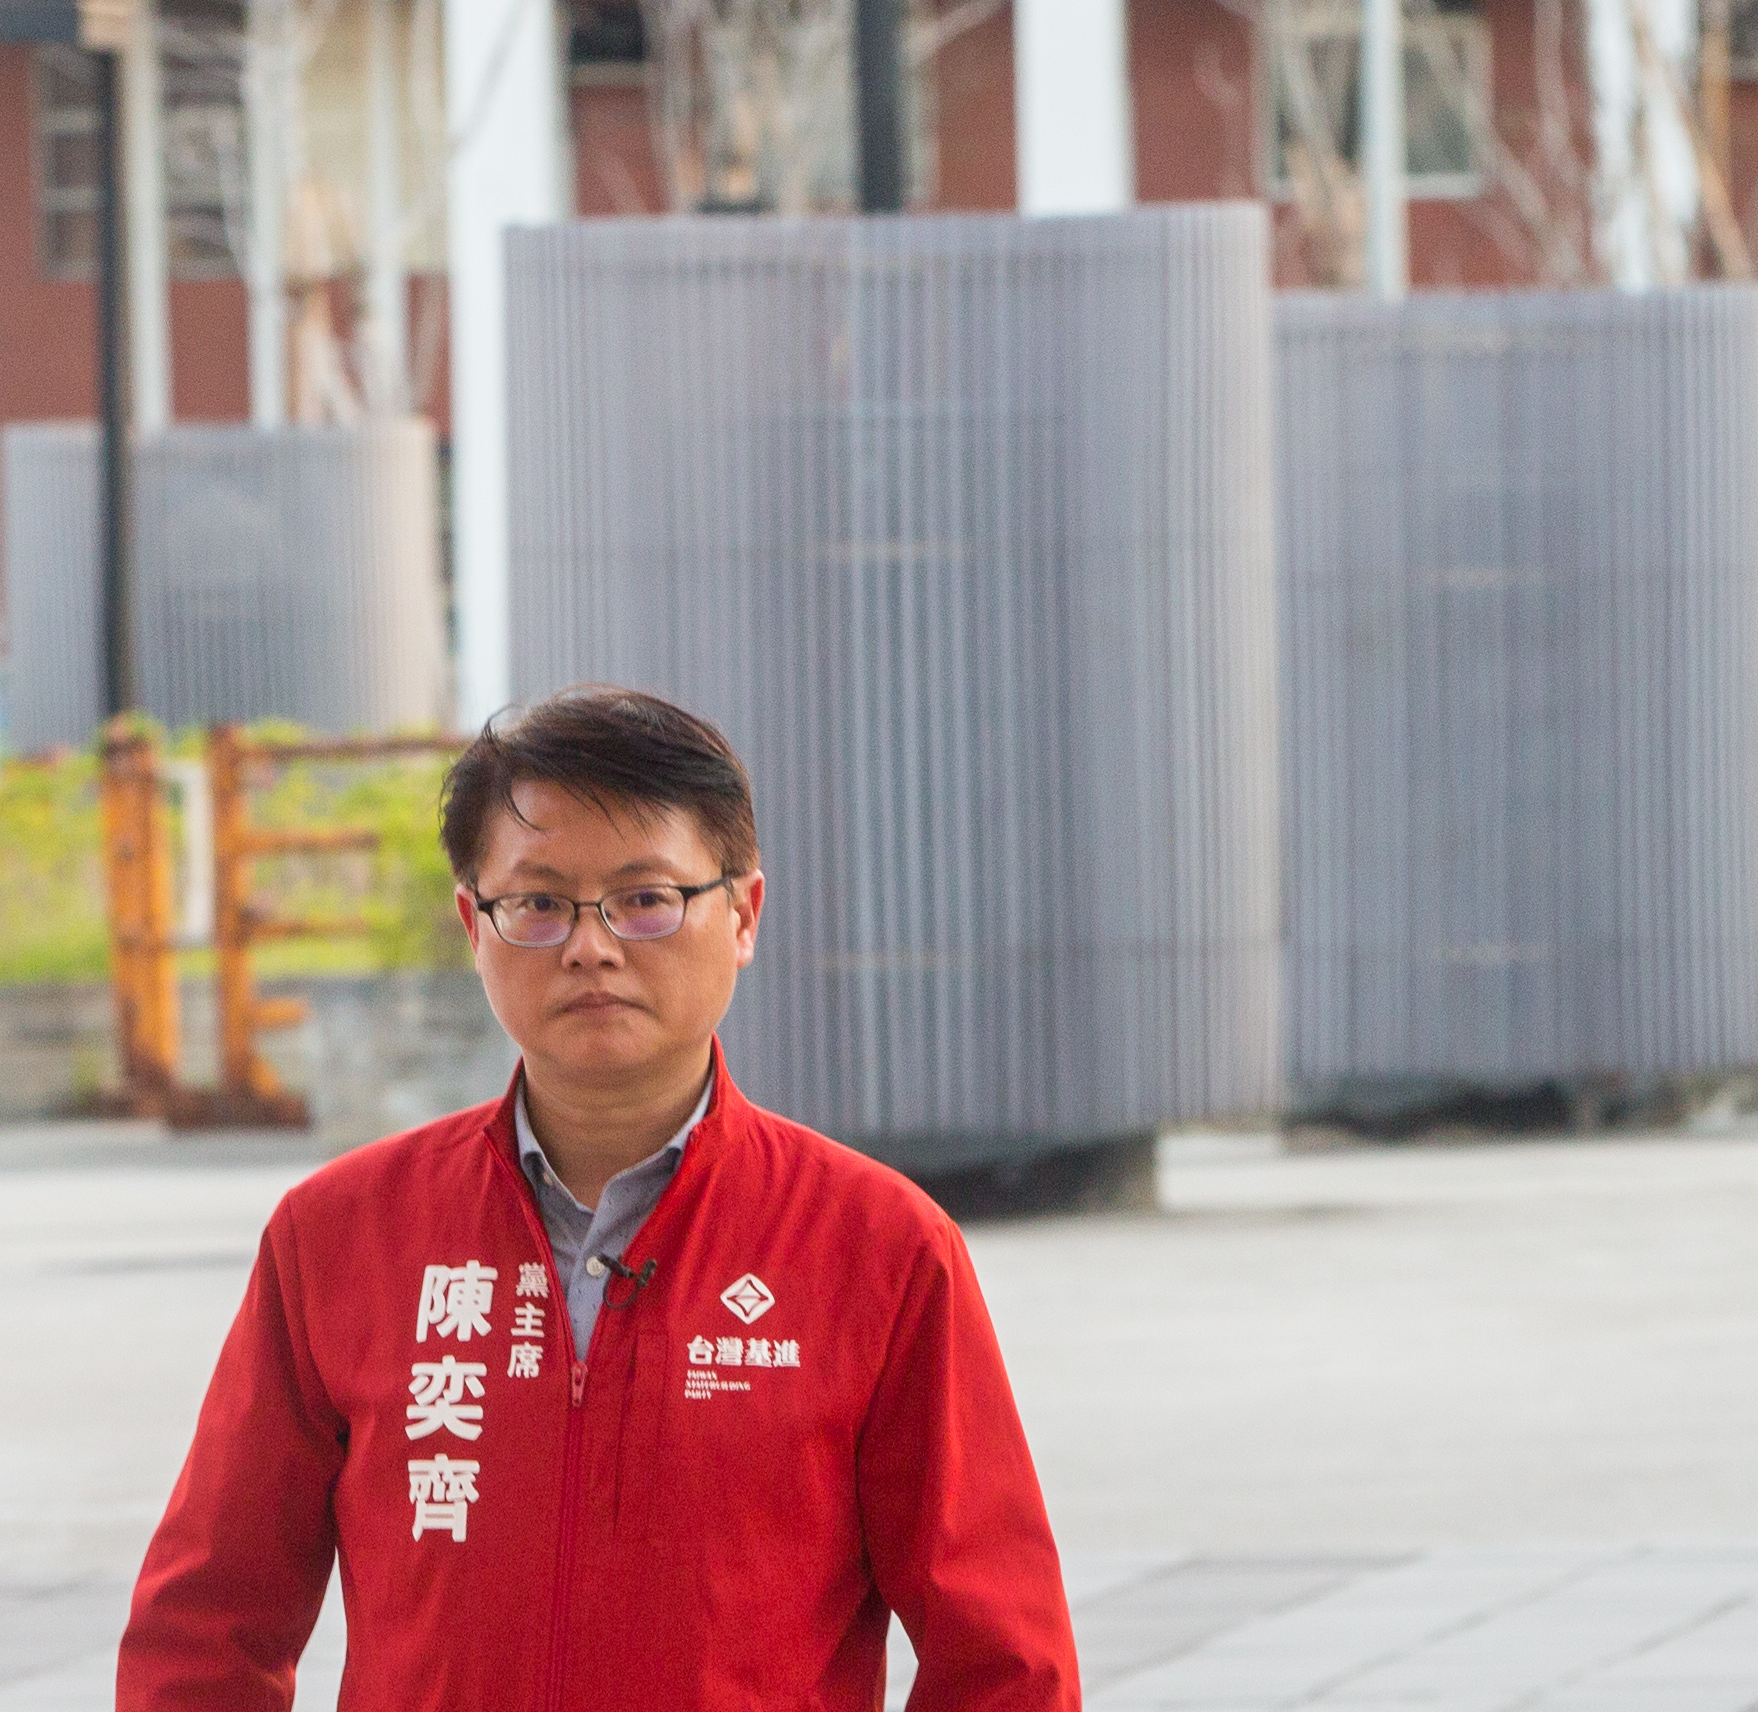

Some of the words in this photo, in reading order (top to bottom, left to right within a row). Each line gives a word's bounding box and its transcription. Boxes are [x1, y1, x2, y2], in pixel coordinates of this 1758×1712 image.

[507, 1261, 549, 1379] 黨主席
[687, 1335, 801, 1368] 台灣基進
[405, 1259, 498, 1543] 陳奕齊
